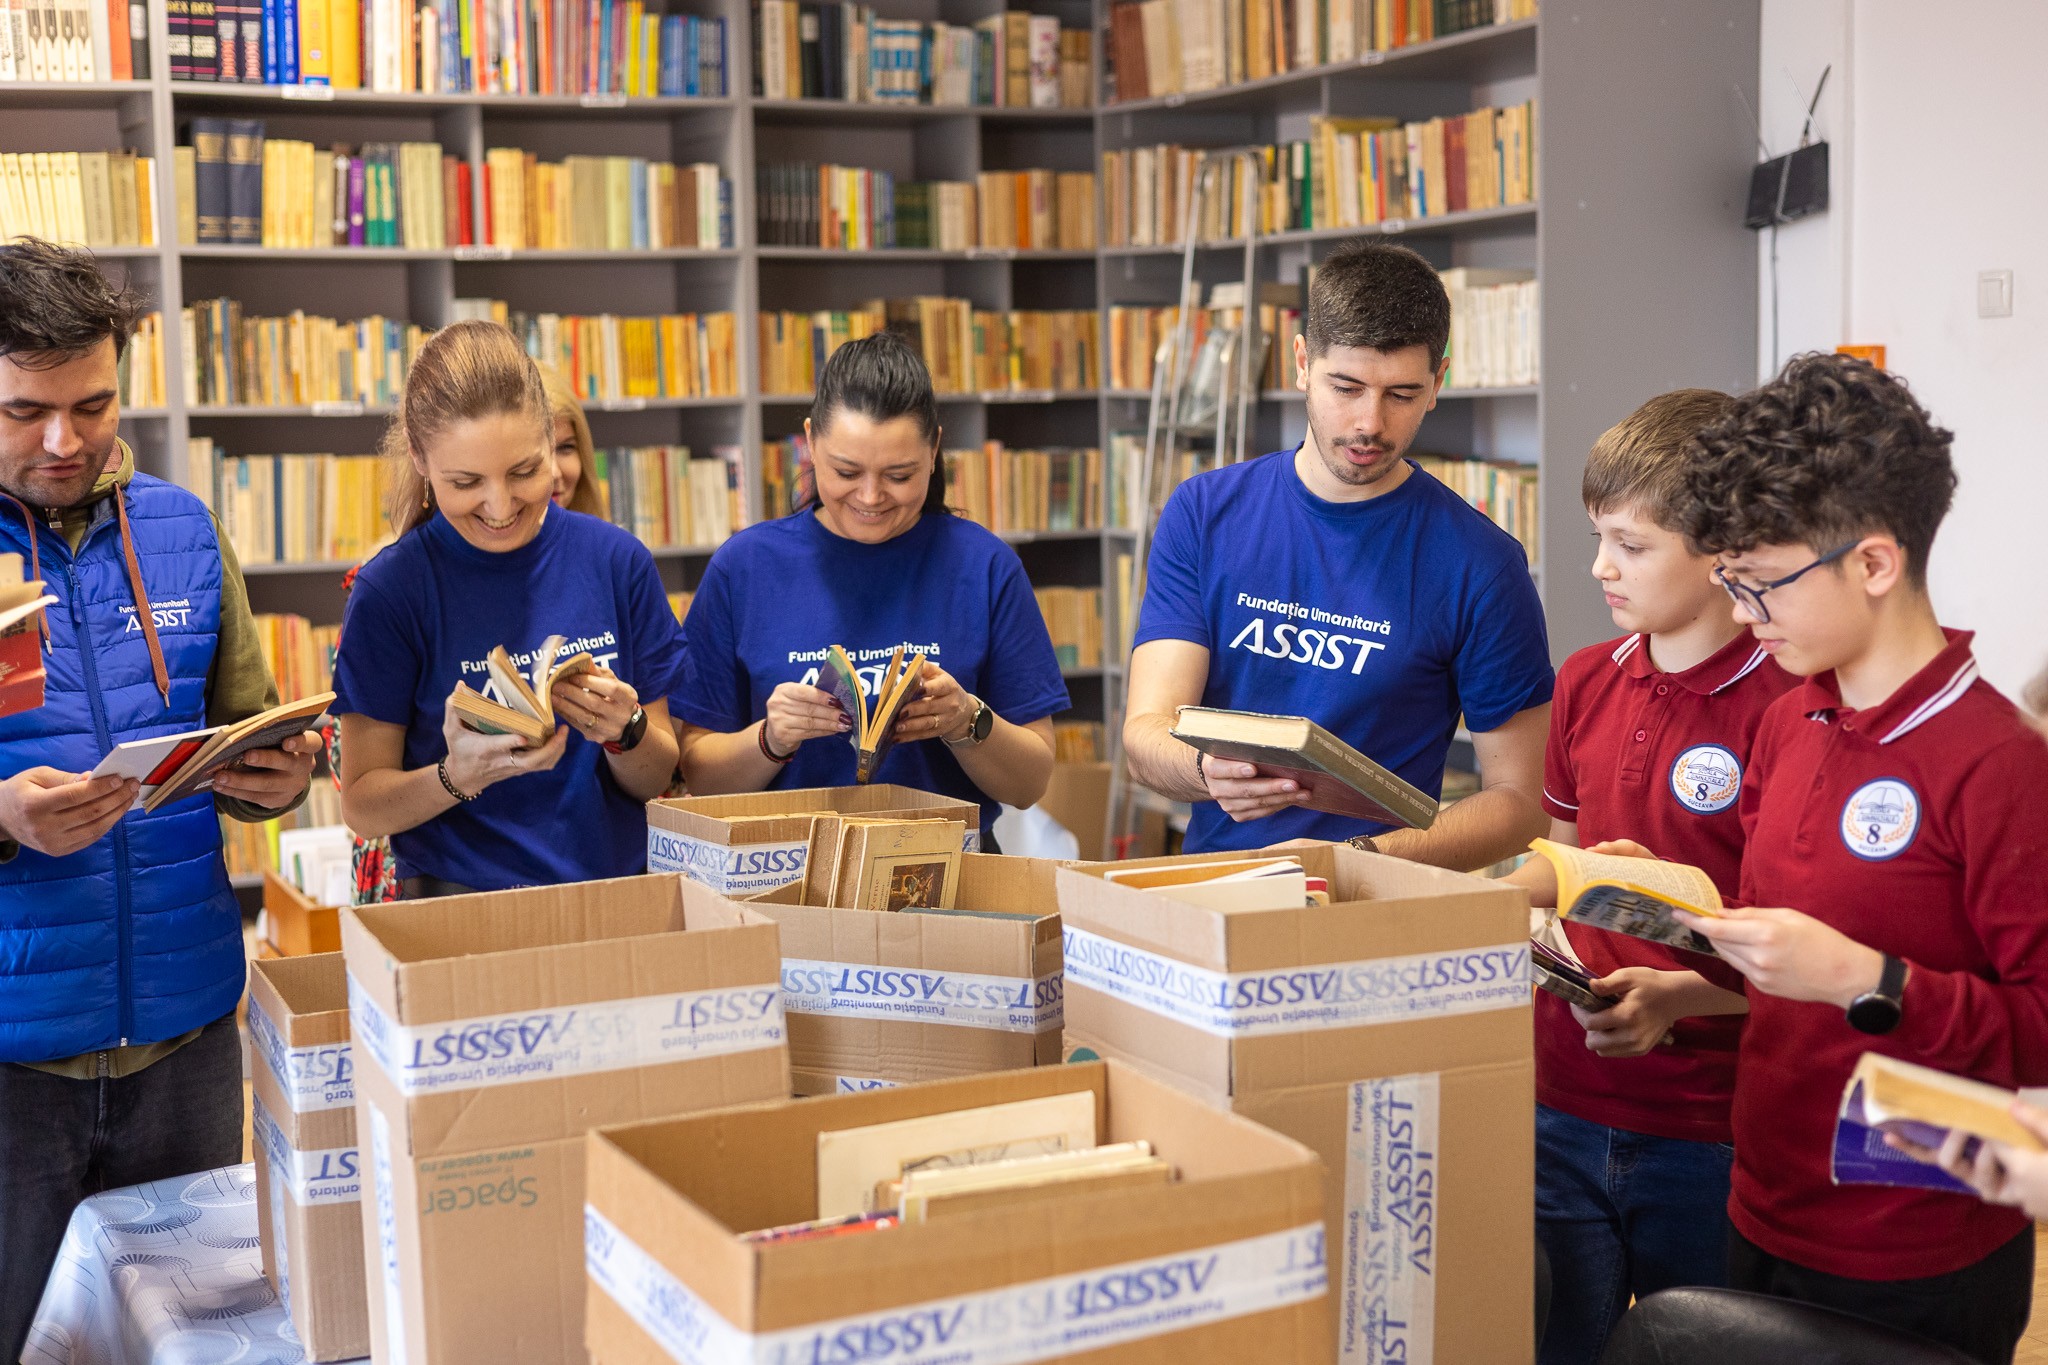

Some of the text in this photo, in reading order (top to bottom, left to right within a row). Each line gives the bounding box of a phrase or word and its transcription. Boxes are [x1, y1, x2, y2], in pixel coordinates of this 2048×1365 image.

[125, 609, 192, 634] ASIST
[1237, 592, 1391, 635] Fundația Umanitară
[461, 631, 615, 675] Funția Uanitară
[1229, 618, 1386, 675] ASSIST
[1695, 783, 1709, 801] 8
[1866, 823, 1882, 845] 8
[726, 847, 810, 876] SSIST
[831, 968, 945, 1000] ASSIST
[1214, 970, 1336, 1012] ASSIST
[830, 999, 945, 1017] Fundația Umanitară
[404, 1021, 551, 1070] ASSIST
[1387, 1090, 1413, 1229] ASSIST
[310, 1183, 360, 1199] anitară
[422, 1176, 538, 1216] Spacer
